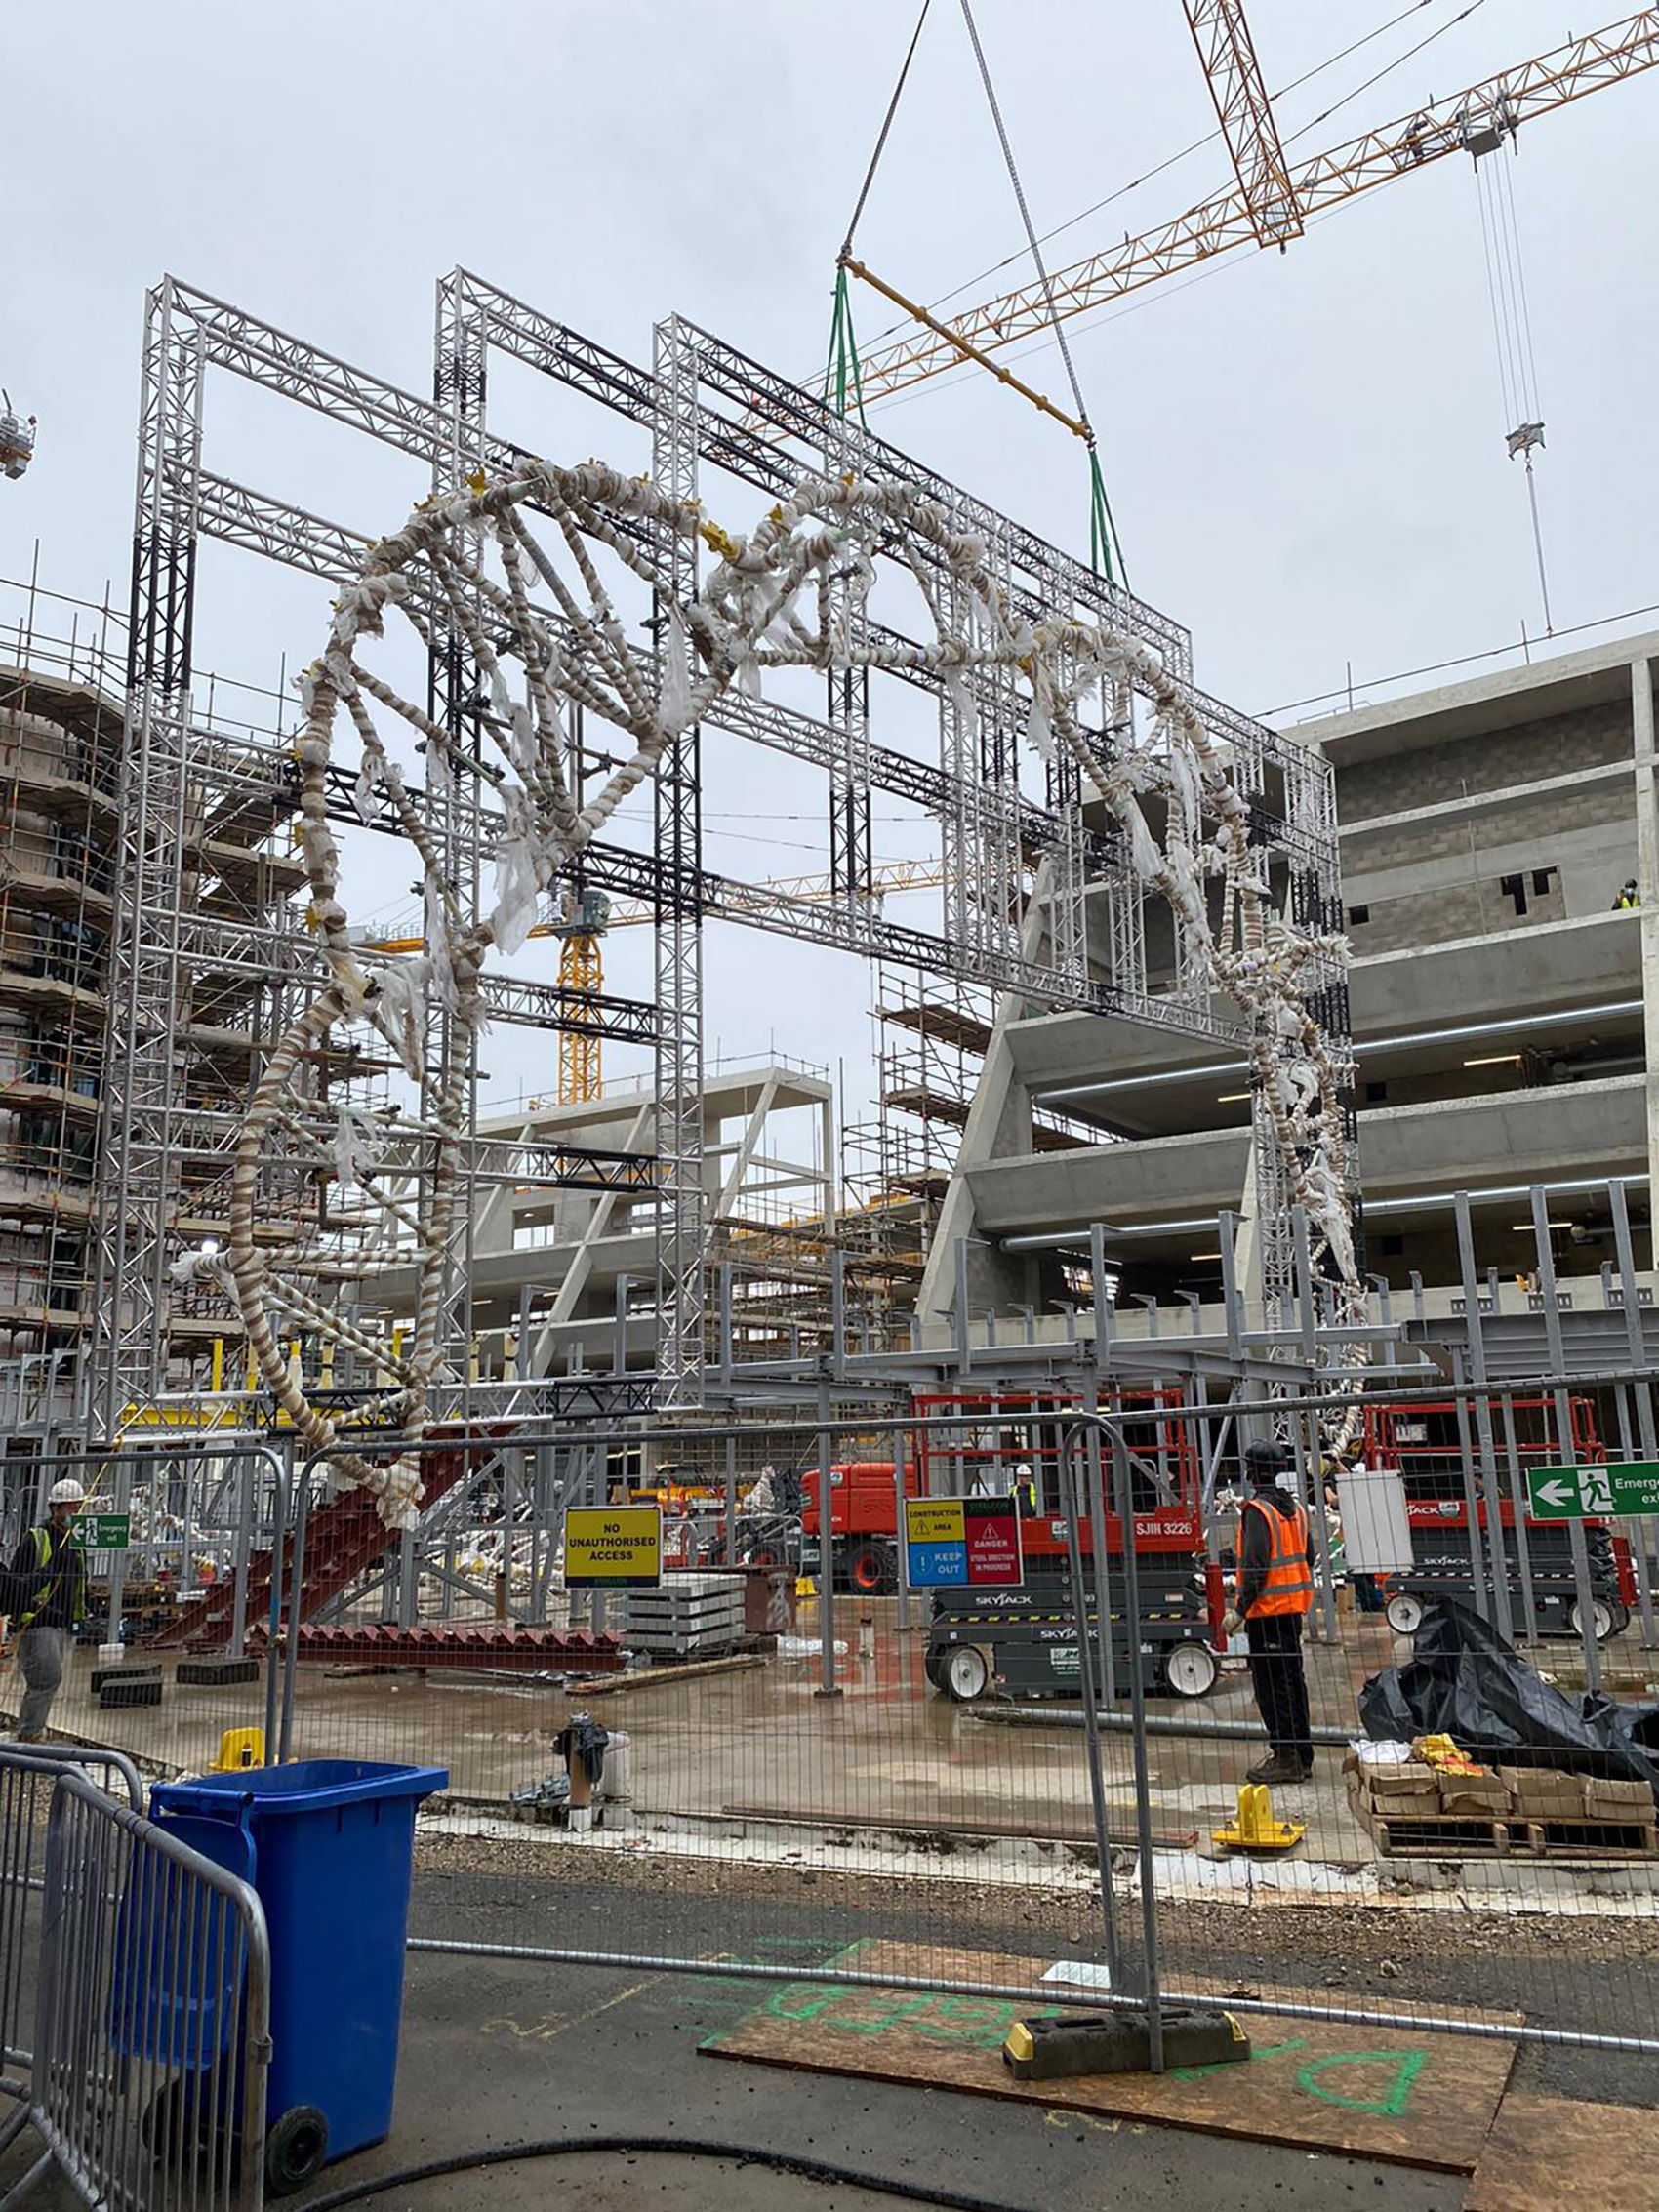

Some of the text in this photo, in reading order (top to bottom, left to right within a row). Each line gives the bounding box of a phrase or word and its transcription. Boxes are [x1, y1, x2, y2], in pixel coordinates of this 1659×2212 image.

[910, 1509, 961, 1518] CONSTRUCTION
[603, 1523, 620, 1533] NO
[1163, 1522, 1192, 1535] 3226
[569, 1537, 656, 1548] UNAUTHORISED
[974, 1540, 1008, 1548] DANGER
[589, 1550, 633, 1561] ACCESS
[934, 1552, 962, 1562] KEEP
[1424, 1555, 1470, 1566] SKYJACK
[938, 1565, 960, 1575] OUT
[976, 1592, 1033, 1607] SKYJACK
[1040, 1627, 1098, 1640] SKYJAK
